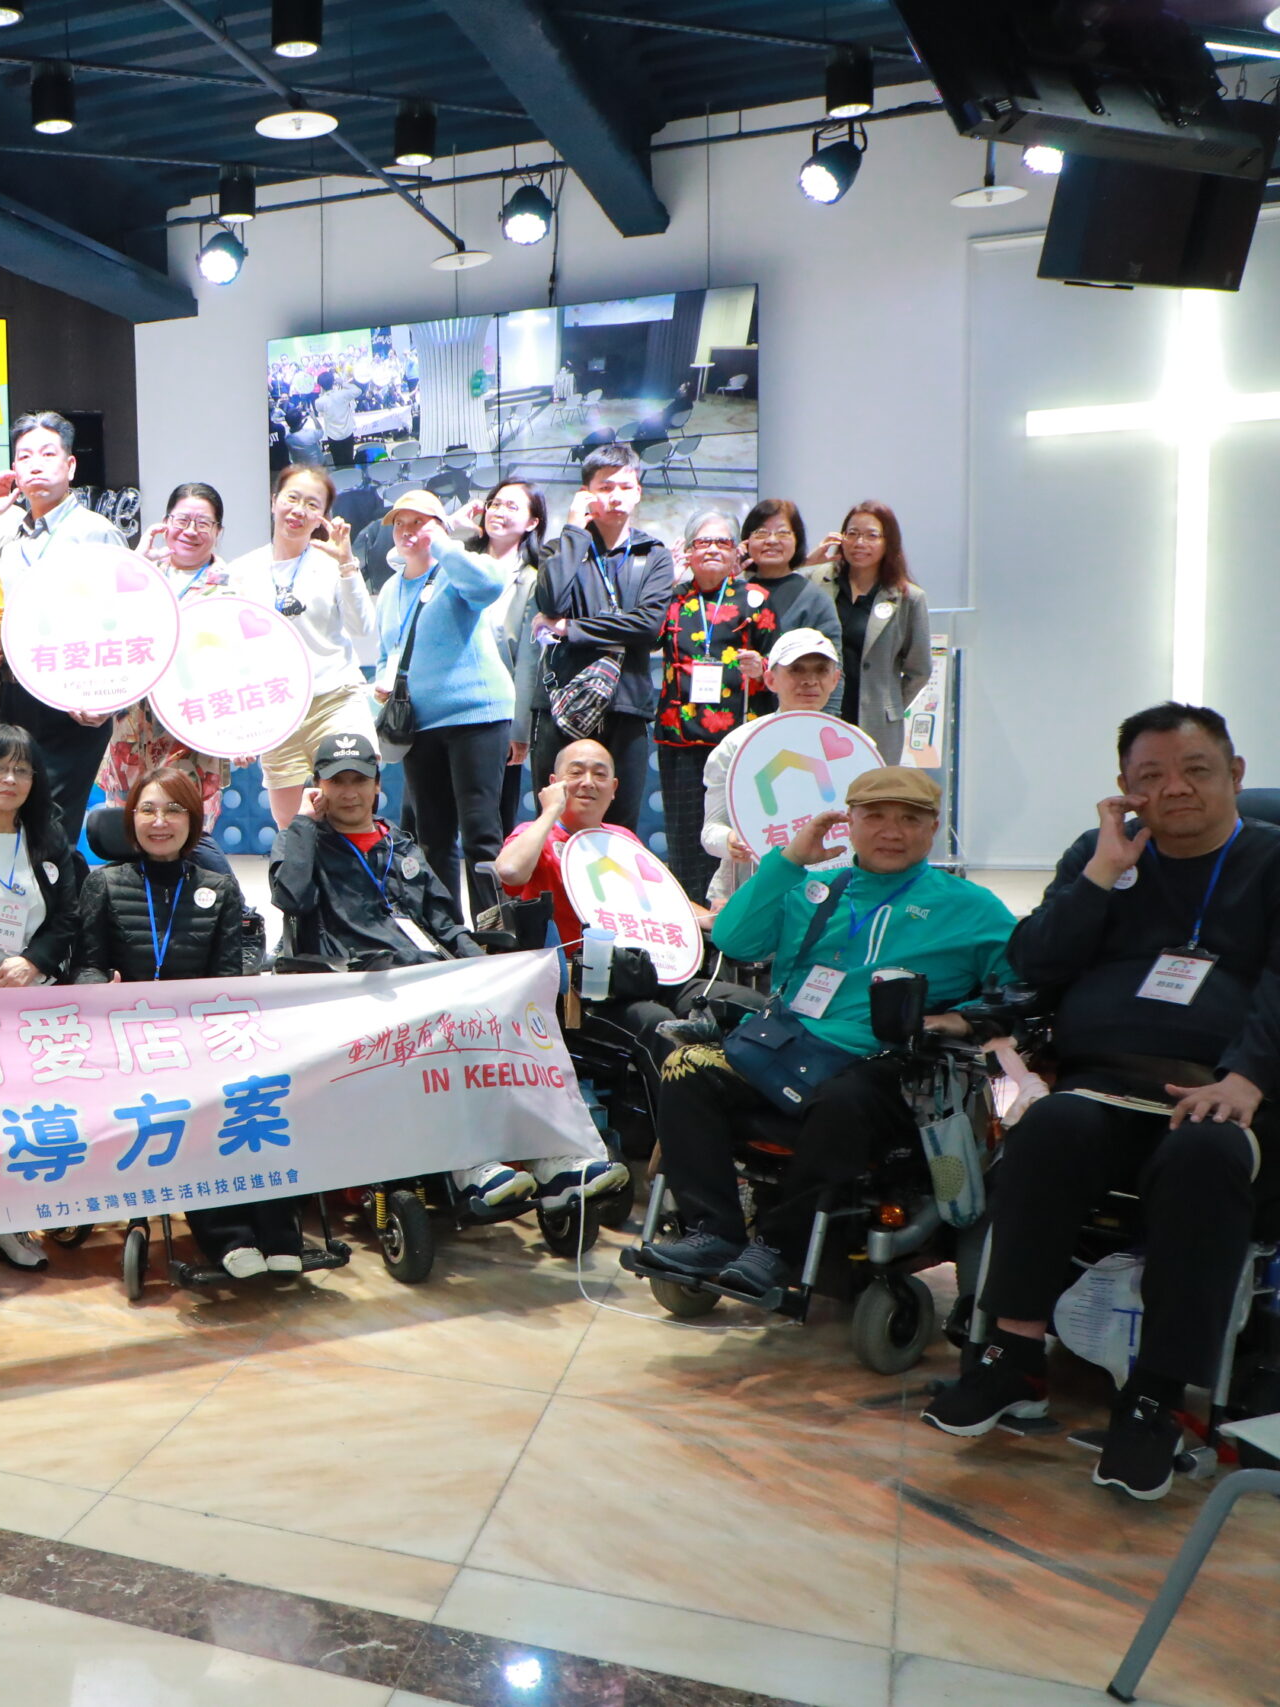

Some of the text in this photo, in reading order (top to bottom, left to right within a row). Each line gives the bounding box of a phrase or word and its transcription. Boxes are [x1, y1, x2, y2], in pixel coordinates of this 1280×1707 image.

[30, 636, 156, 673] 有愛店家
[178, 677, 295, 725] 有愛店家
[333, 748, 360, 758] adidas
[594, 907, 689, 949] 有愛店家
[422, 1062, 565, 1095] IN KEELUNG
